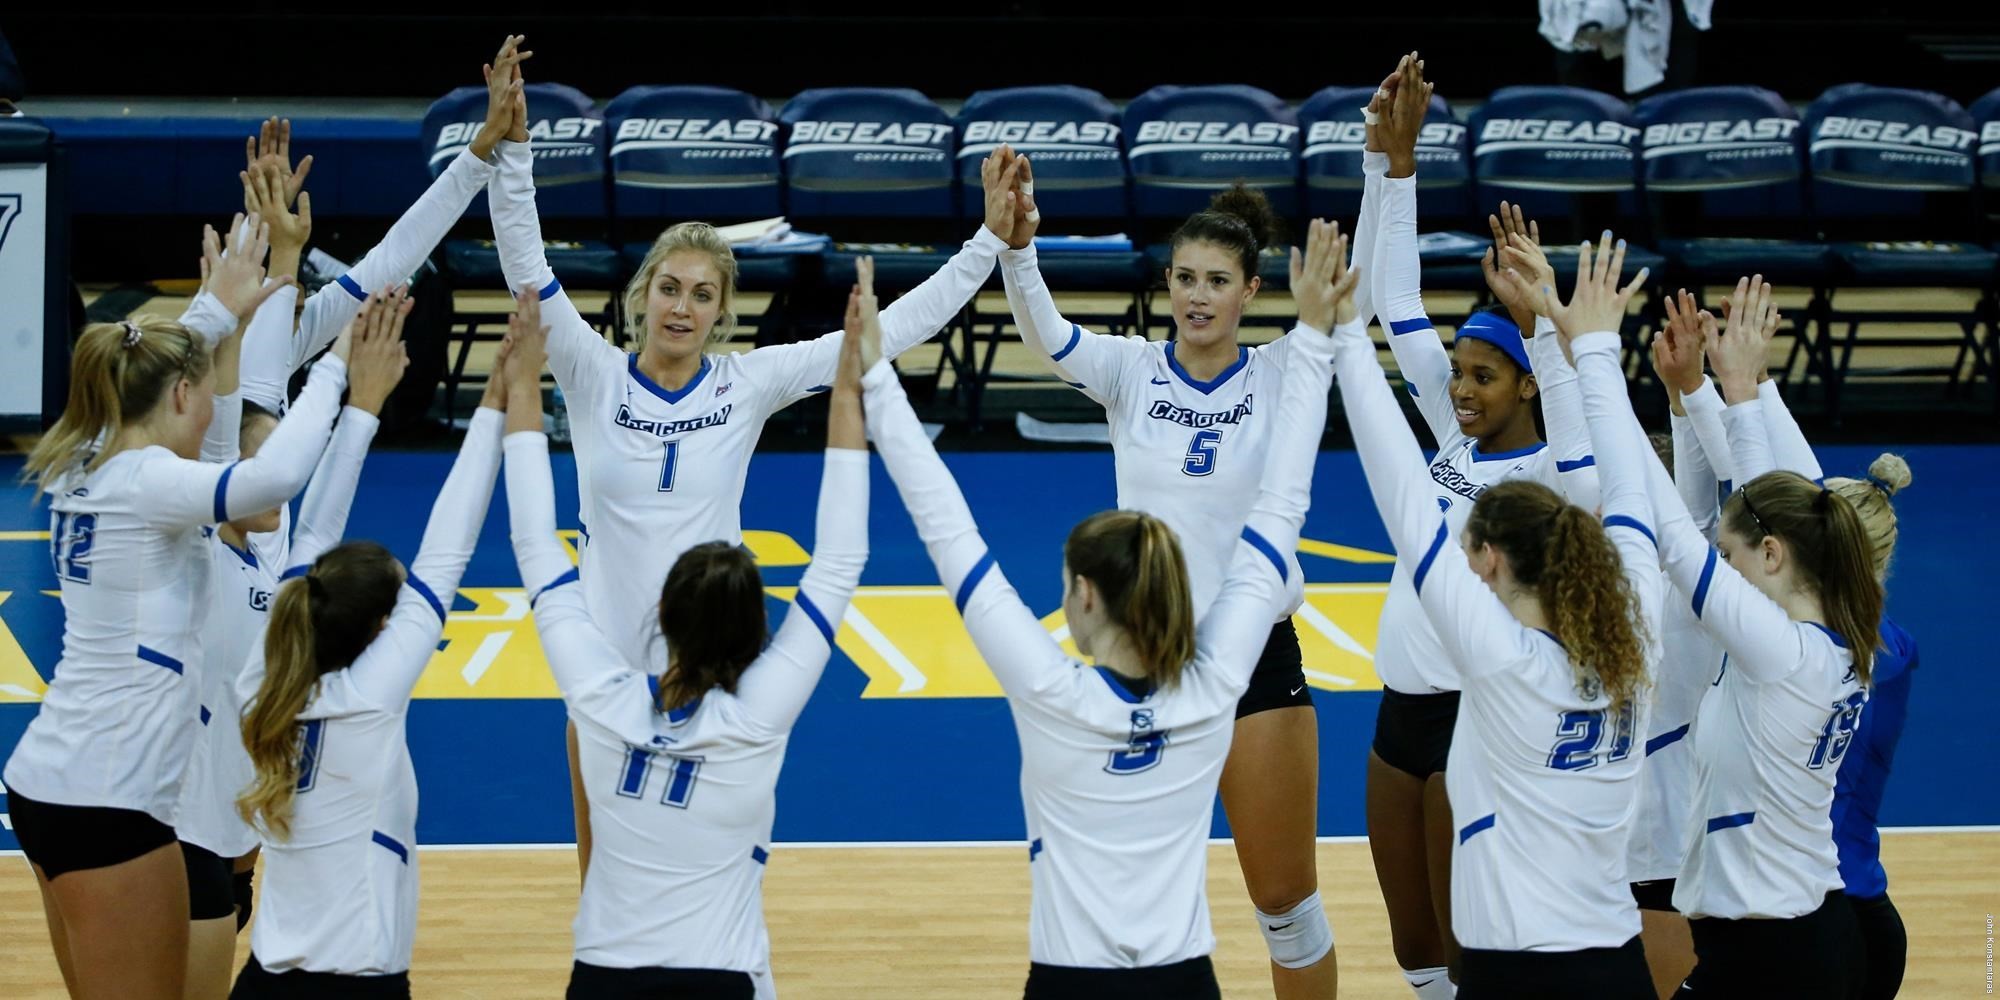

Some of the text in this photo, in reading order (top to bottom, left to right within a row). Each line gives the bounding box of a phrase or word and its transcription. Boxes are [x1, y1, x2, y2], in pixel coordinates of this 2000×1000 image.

[682, 149, 774, 159] CONFERENCE
[853, 152, 945, 162] CONFERENCE
[1029, 151, 1120, 161] CONFERENCE
[657, 439, 680, 492] 1
[1181, 428, 1223, 477] 5
[1545, 693, 1636, 772] 21
[616, 741, 706, 810] 11
